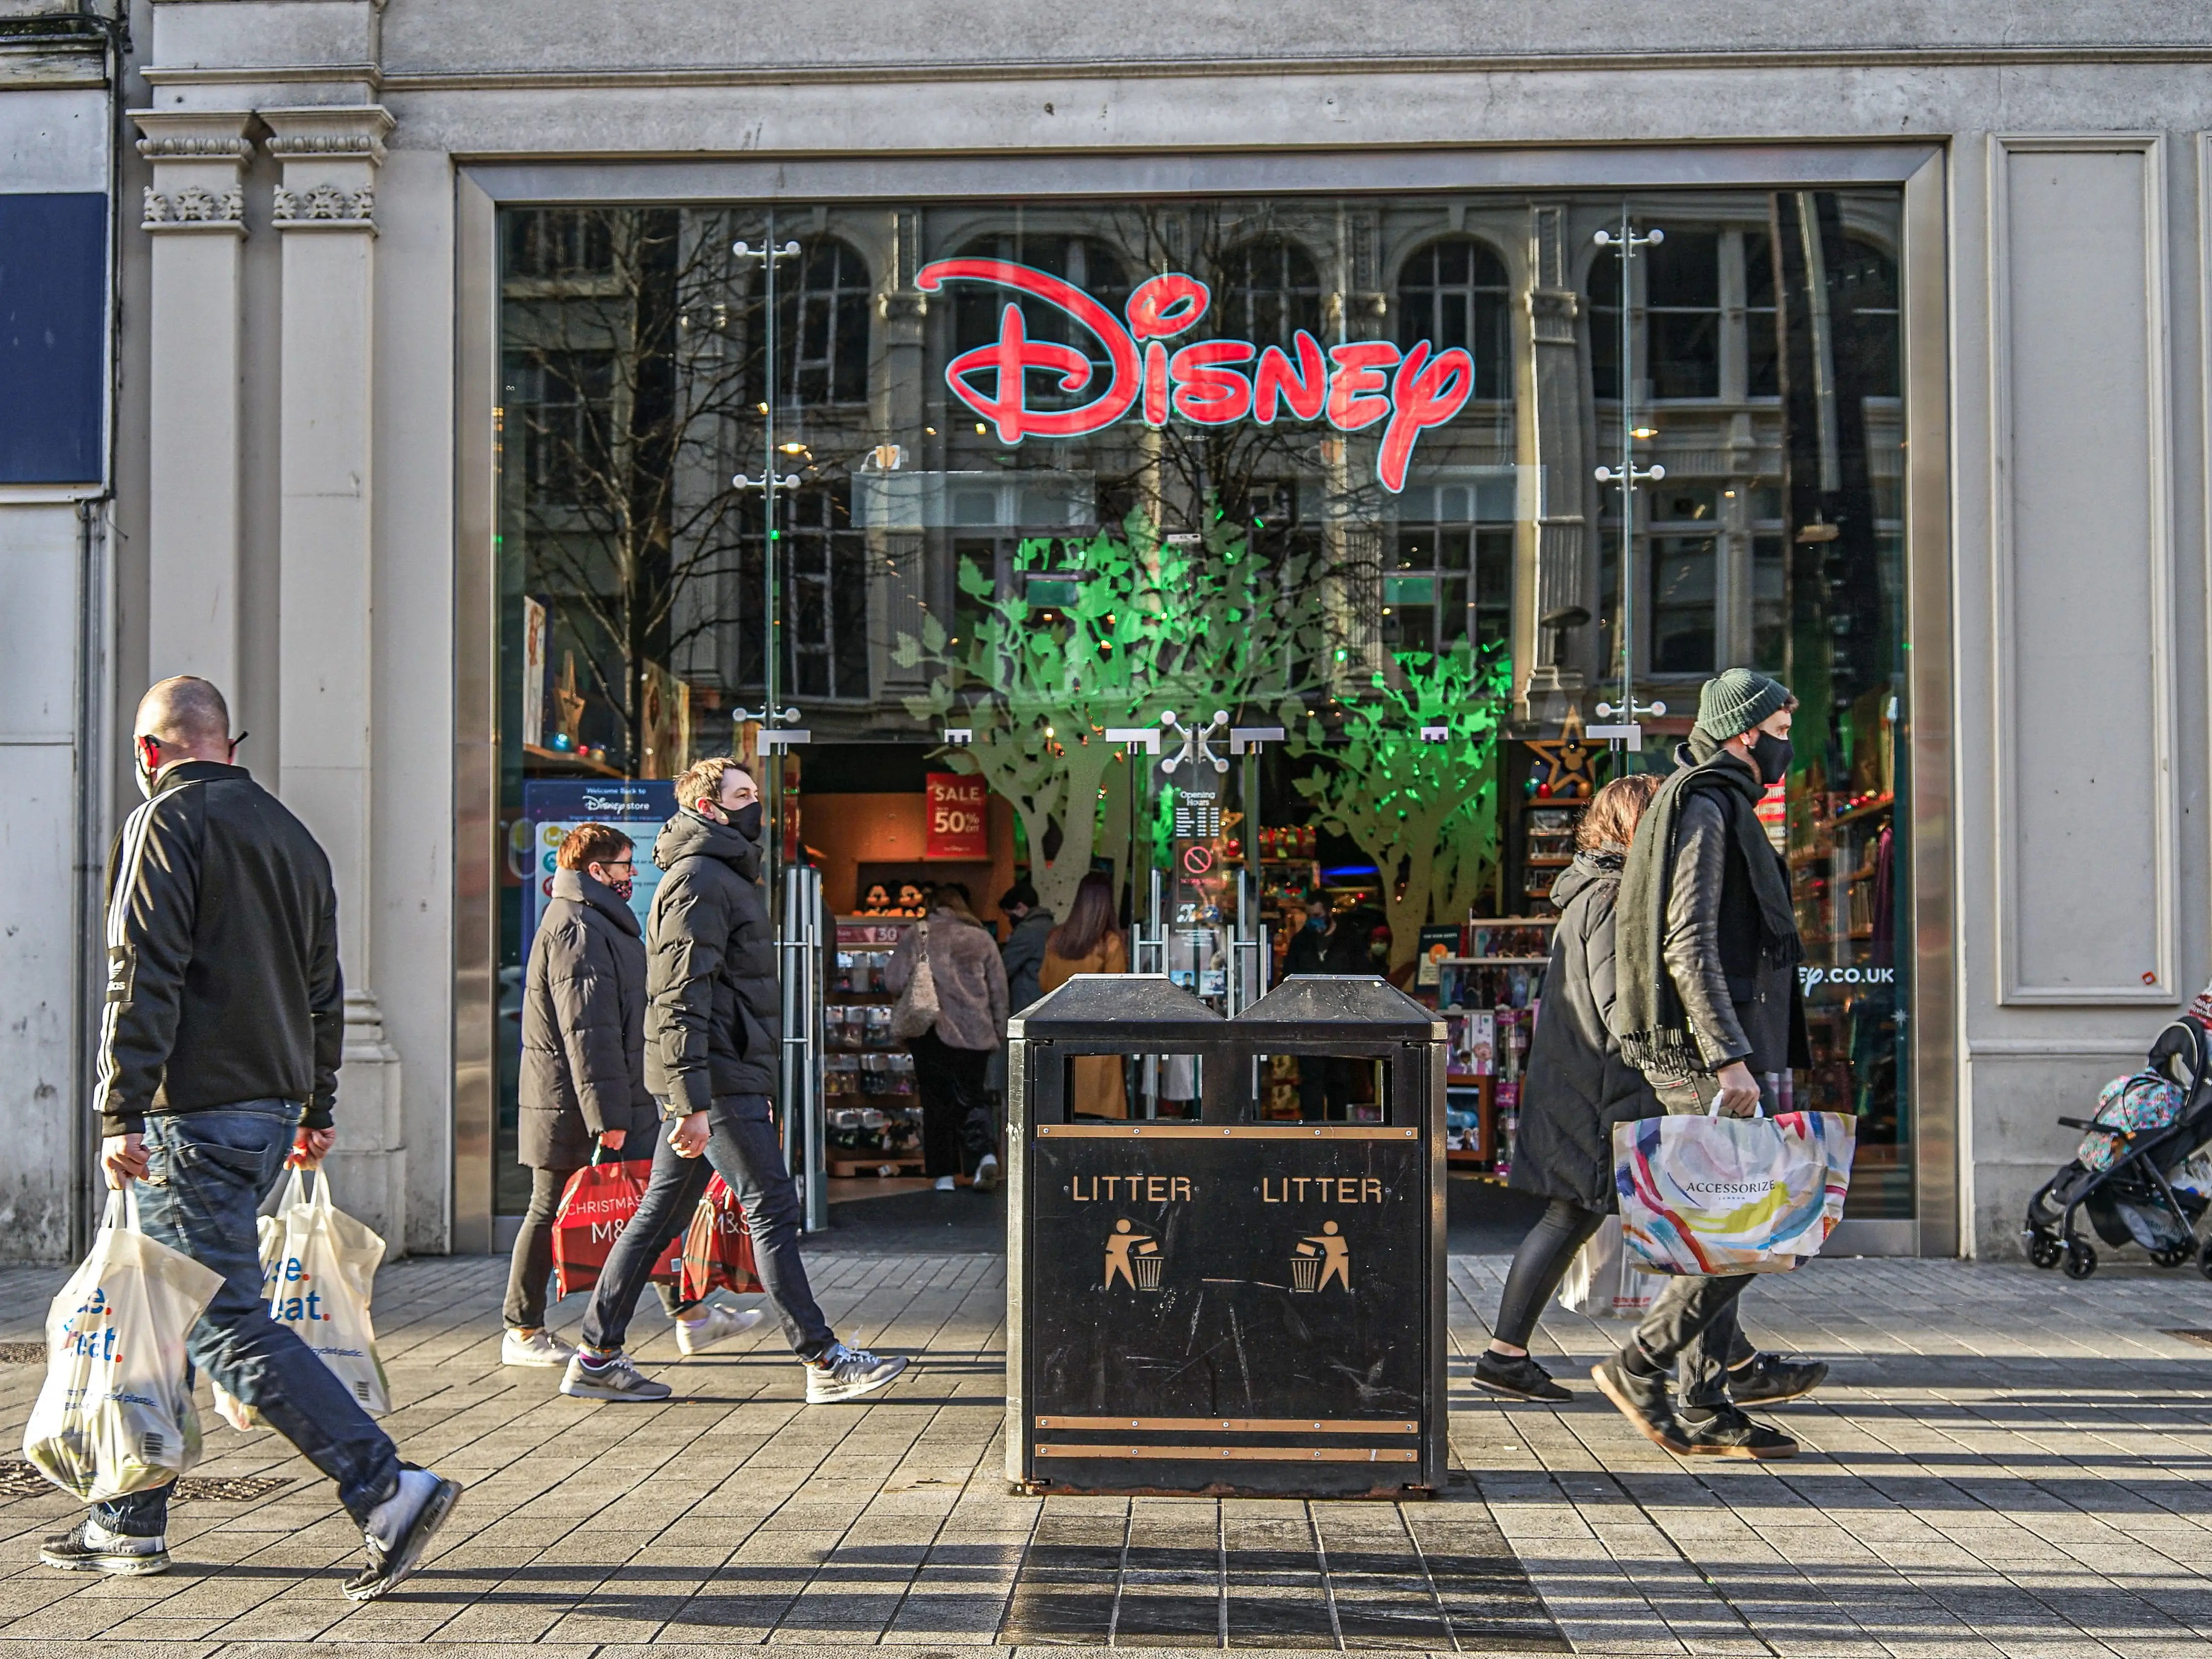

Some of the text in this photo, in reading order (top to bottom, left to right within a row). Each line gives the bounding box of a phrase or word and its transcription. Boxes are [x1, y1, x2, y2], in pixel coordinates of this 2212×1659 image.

[914, 257, 1474, 493] Disney
[934, 785, 980, 802] SALE
[1180, 791, 1216, 800] Opening
[1072, 1176, 1192, 1202] LITTER
[1263, 1177, 1382, 1204] LITTER
[1687, 1179, 1775, 1194] ACCESSORIZE
[567, 1195, 643, 1216] CHRISTMAS
[591, 1218, 625, 1244] M&
